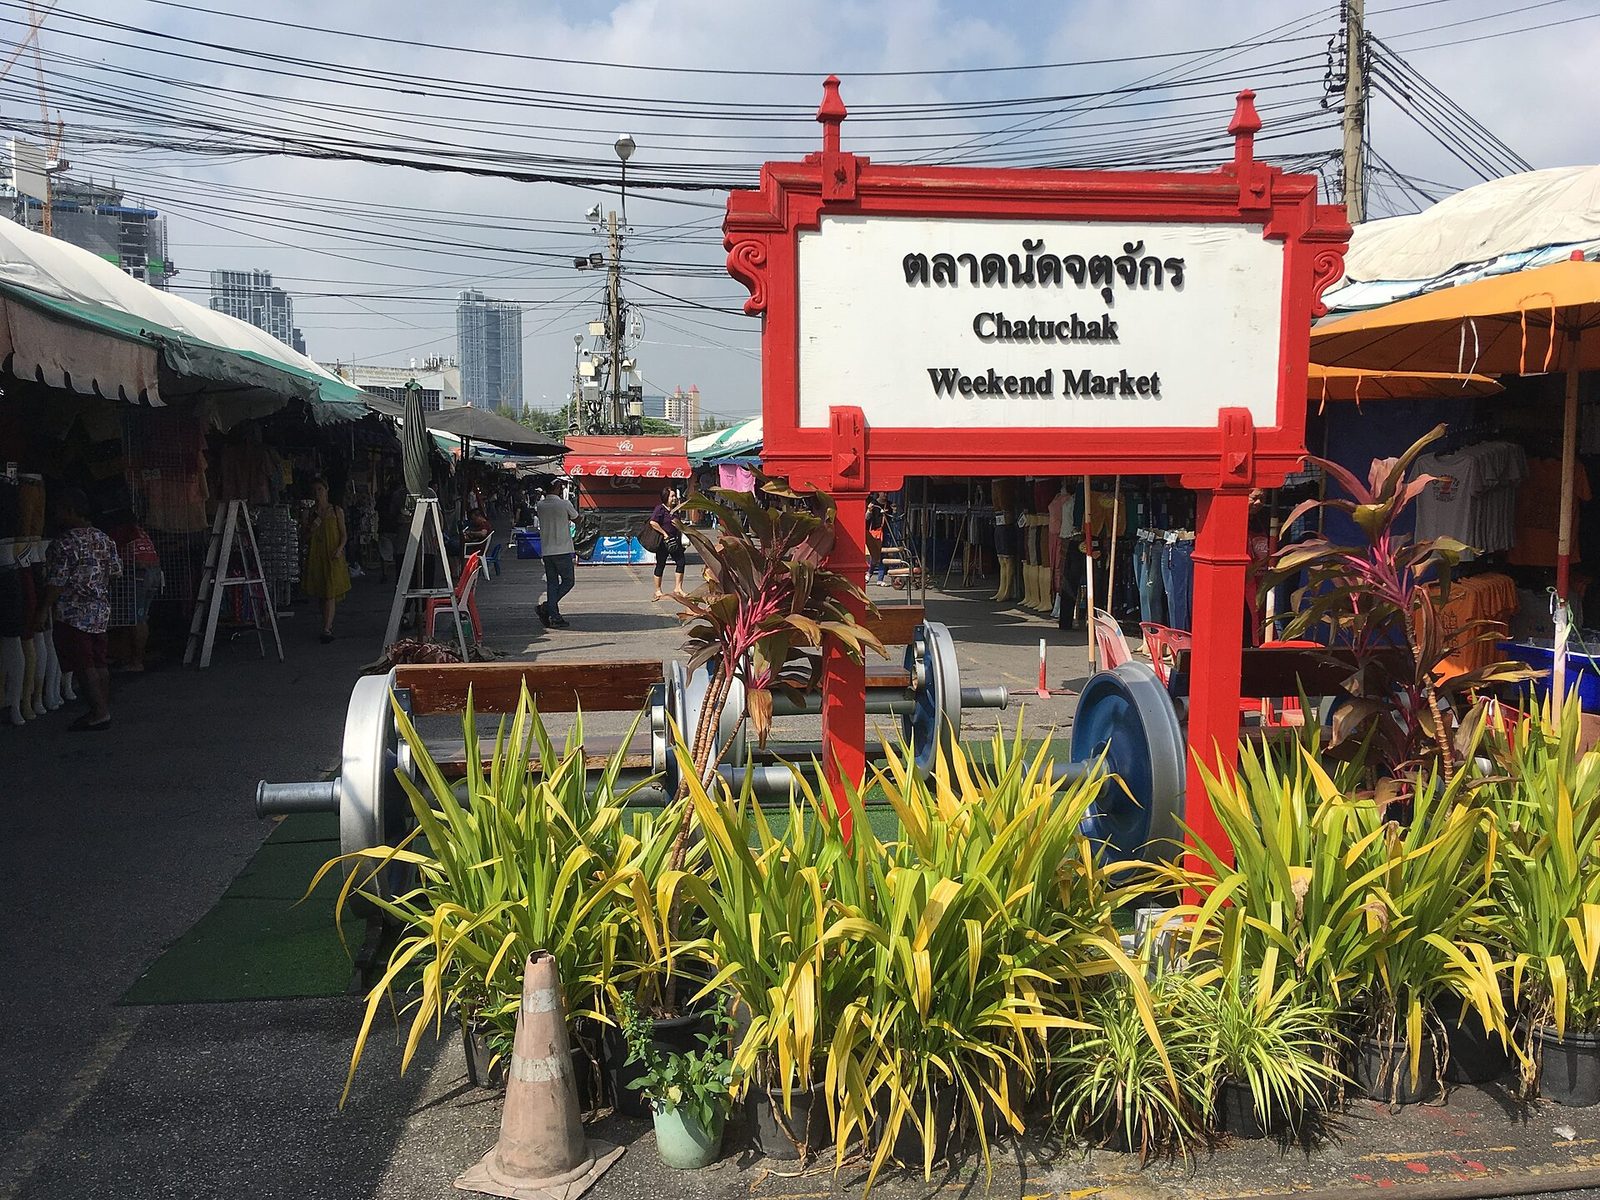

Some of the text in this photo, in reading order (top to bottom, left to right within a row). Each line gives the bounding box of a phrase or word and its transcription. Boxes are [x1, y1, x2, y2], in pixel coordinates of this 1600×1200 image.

[902, 238, 1186, 305] ตลาดนัดจตุจักร
[972, 311, 1120, 342] Chatuchak
[927, 367, 1162, 398] Weekend Market
